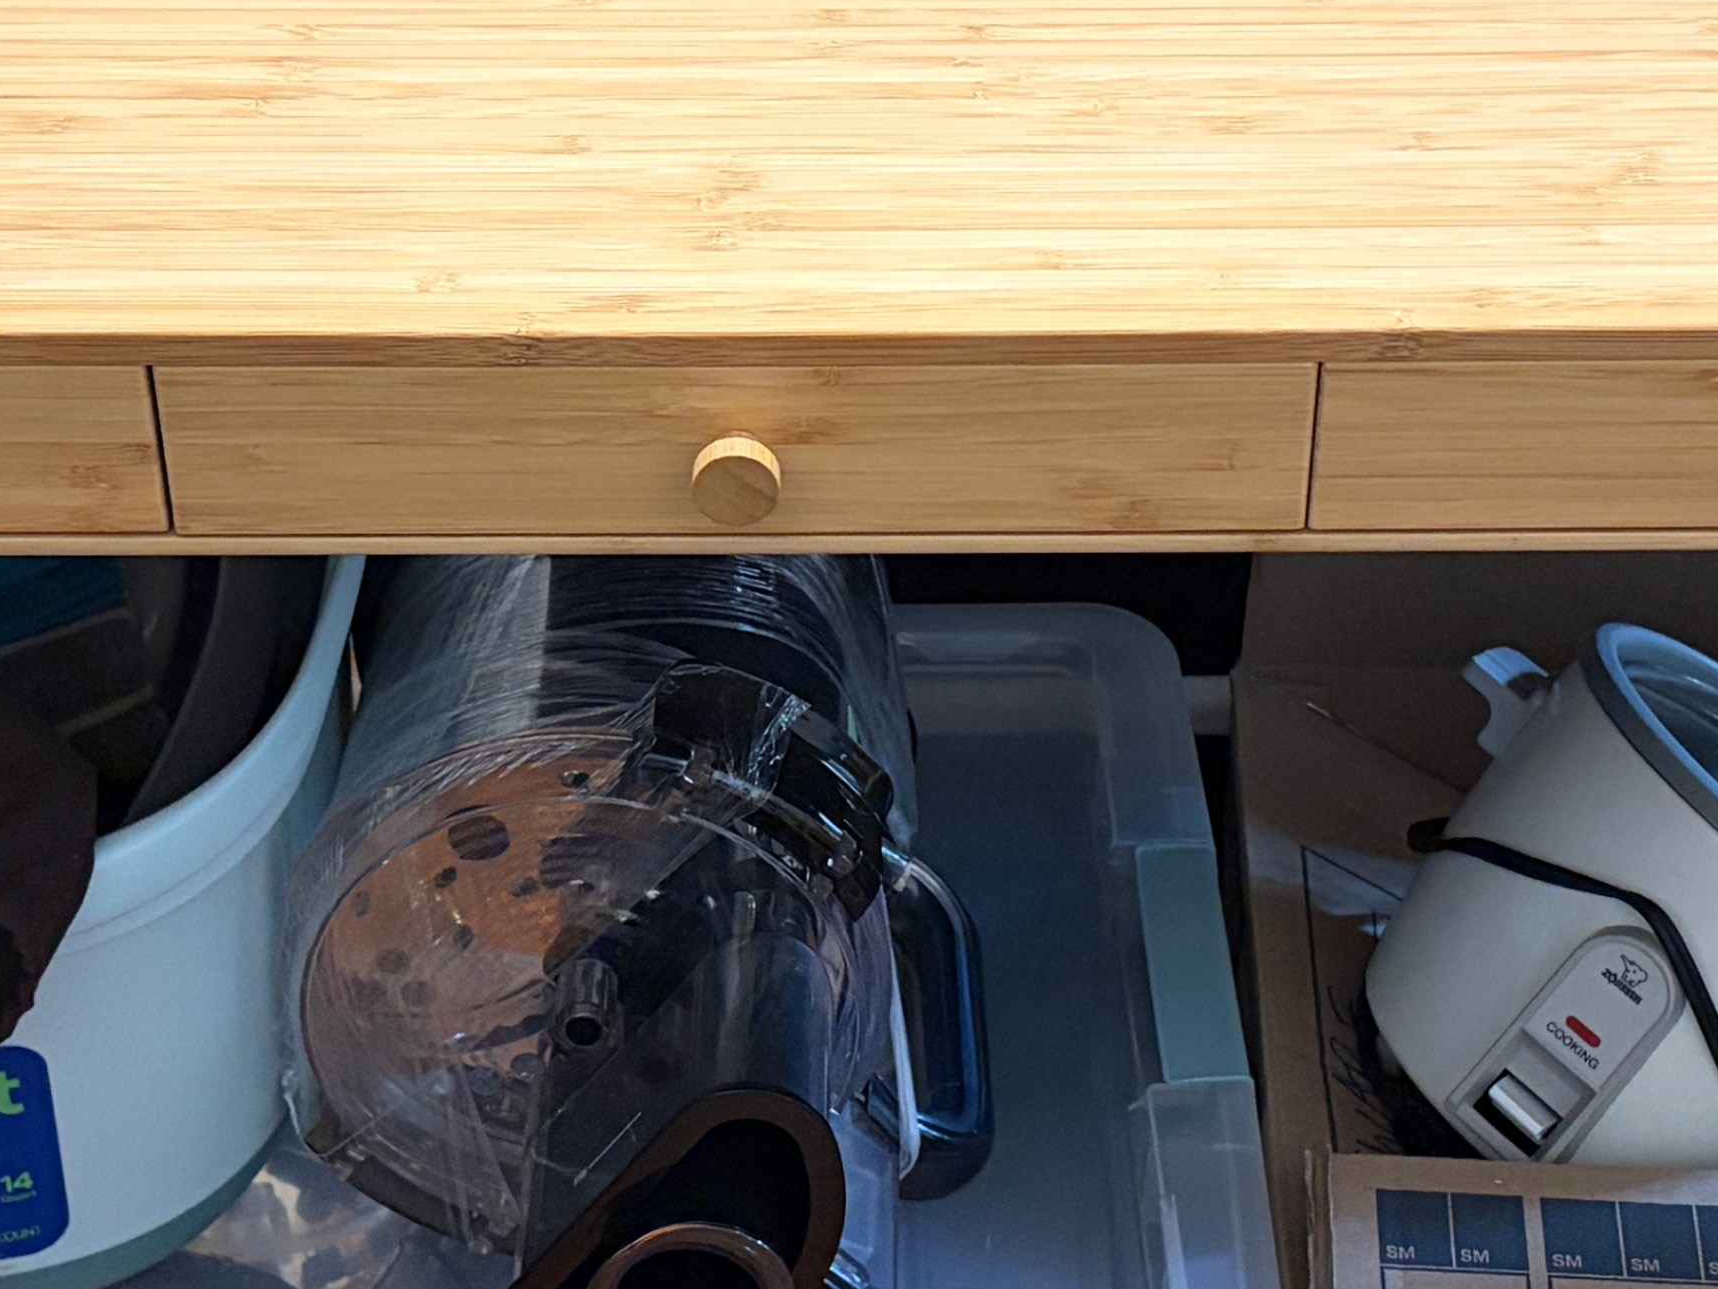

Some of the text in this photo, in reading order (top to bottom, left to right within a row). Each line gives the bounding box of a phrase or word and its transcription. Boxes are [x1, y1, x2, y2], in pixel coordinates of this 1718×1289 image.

[1546, 1021, 1600, 1070] COOKING
[0, 1171, 34, 1193] 14
[1386, 1245, 1415, 1259] SM
[1460, 1248, 1490, 1263] SM
[1552, 1253, 1582, 1268] SM
[1631, 1258, 1660, 1272] SM
